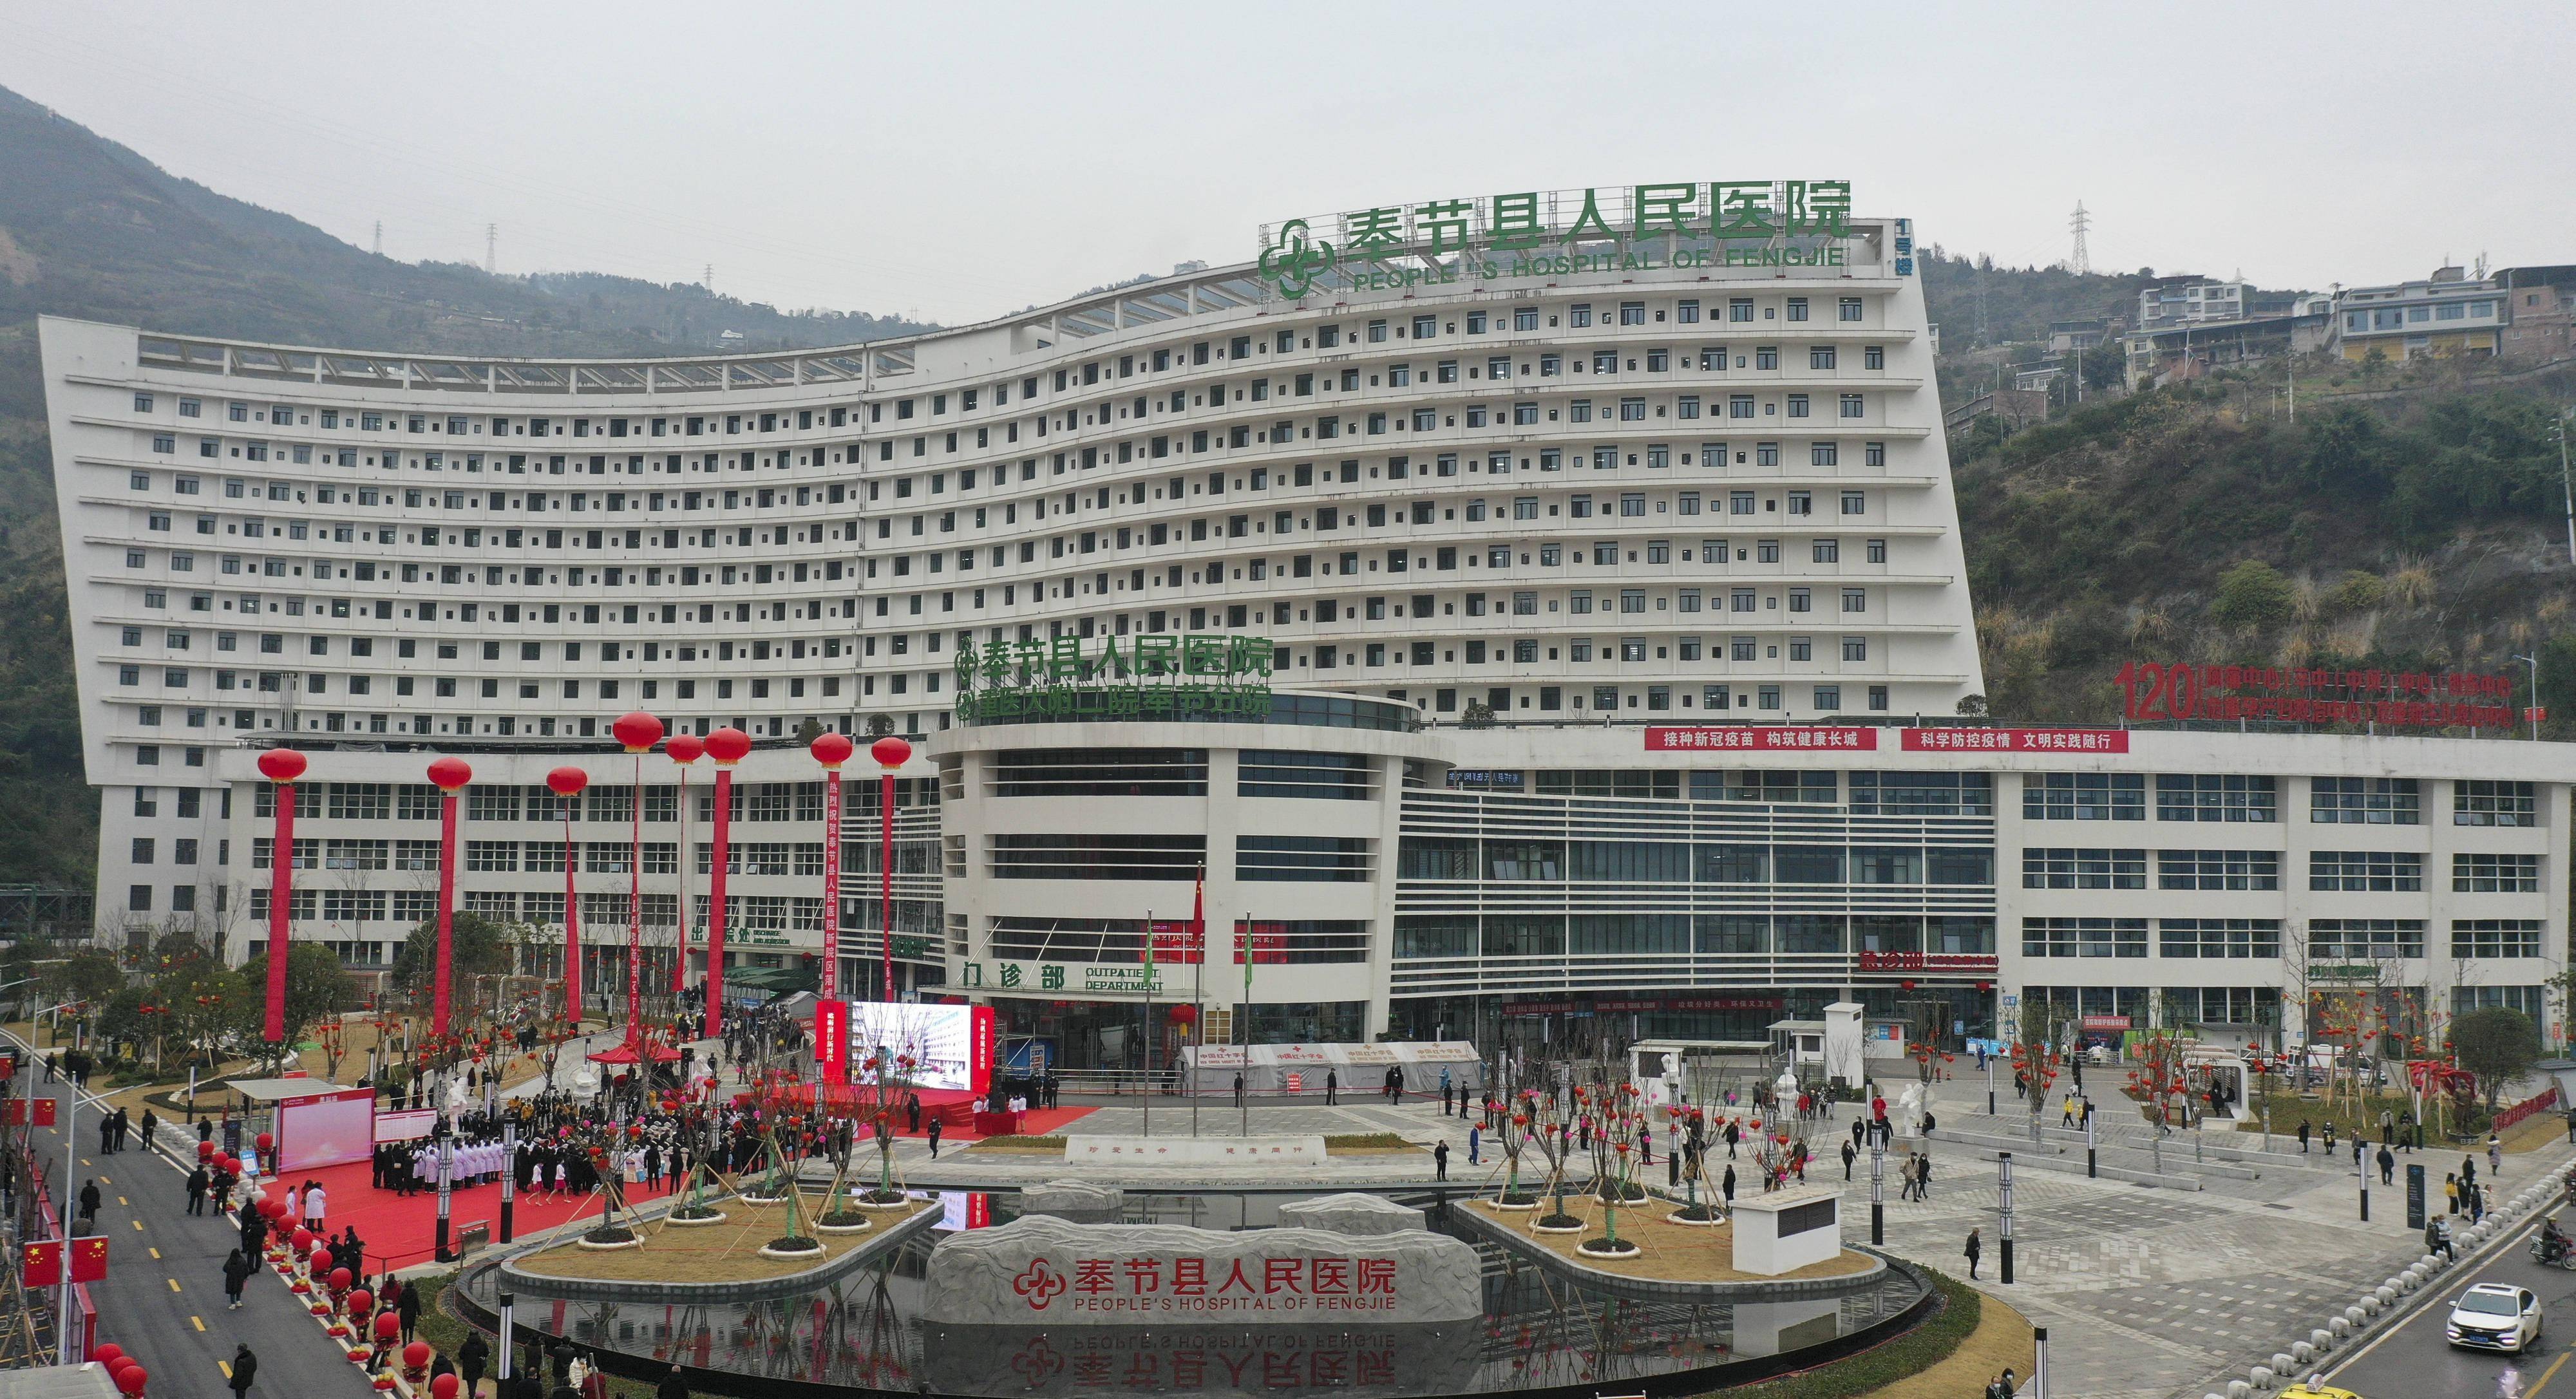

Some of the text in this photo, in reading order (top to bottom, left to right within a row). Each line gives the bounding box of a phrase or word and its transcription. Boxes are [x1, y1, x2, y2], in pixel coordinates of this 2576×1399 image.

[1345, 181, 1851, 263] 奉节县人民医院
[1513, 252, 1657, 277] HOSPITAL
[1672, 249, 1710, 269] OF
[1725, 247, 1844, 268] FENGJIE
[1895, 218, 1912, 276] 1号楼
[982, 635, 1273, 677] 奉节县人民医院
[980, 682, 1273, 718] 重医大附二院奉节分院
[2112, 662, 2195, 720] 120
[1663, 731, 1859, 747] 接种新冠疫苗 构筑健康长城
[1920, 732, 2111, 749] 科学防控疫情 文明实践随行
[824, 782, 838, 1000] 热烈祝贺奉节县人民医院新院区落成
[963, 961, 1065, 991] 门诊部
[1085, 967, 1159, 978] OUTPATIET
[1085, 981, 1164, 992] DEPARTMENT
[1075, 1258, 1396, 1295] 奉节县人民医院
[1075, 1297, 1396, 1311] PEOPLE'S HOSPITAL OF FENGJIE
